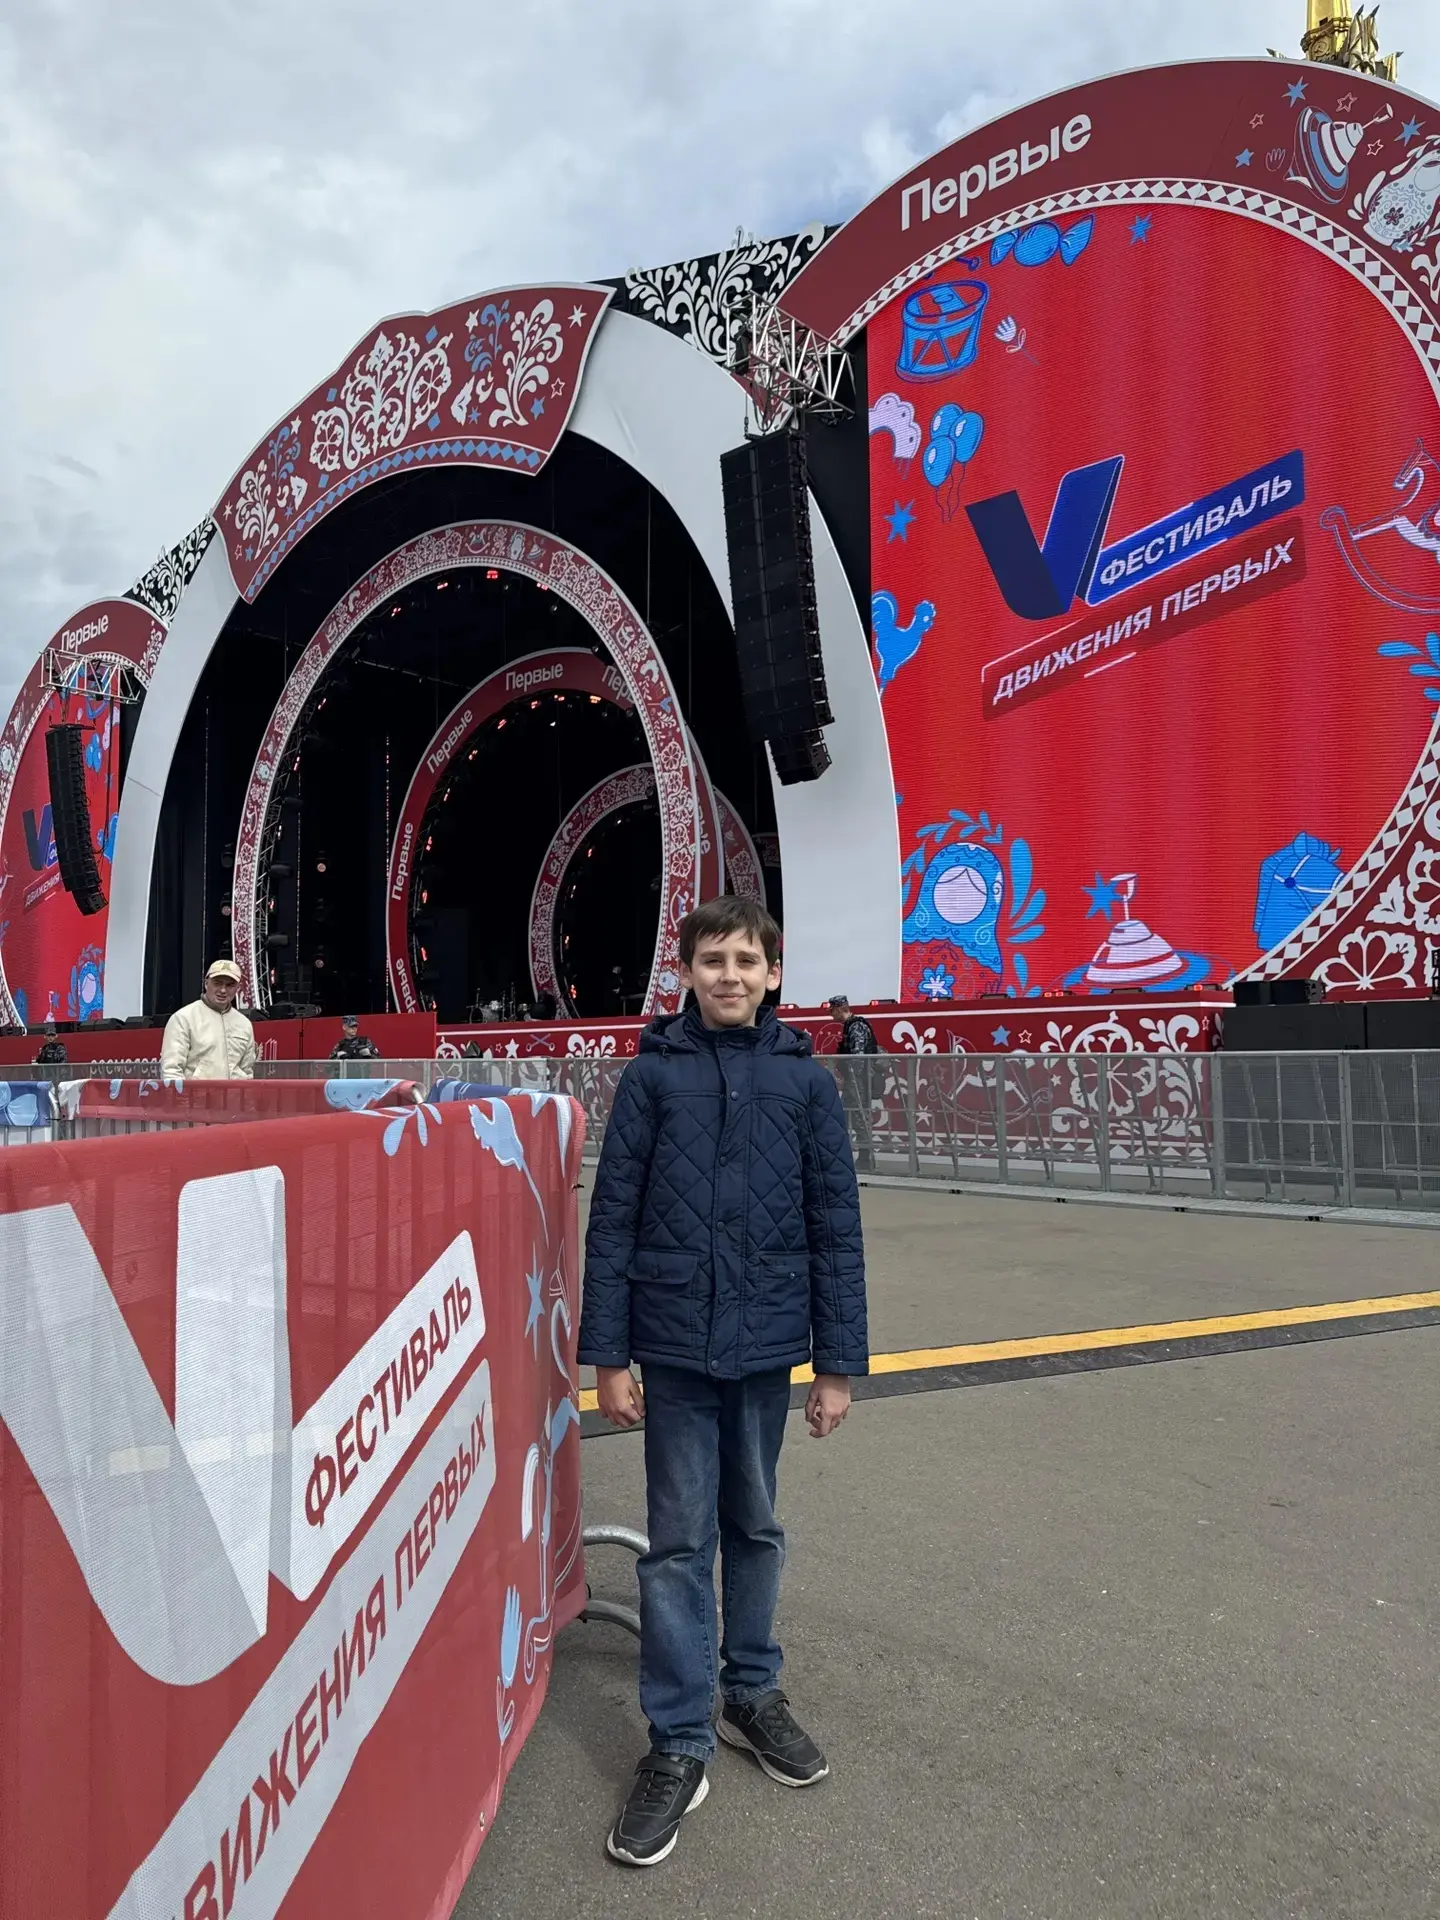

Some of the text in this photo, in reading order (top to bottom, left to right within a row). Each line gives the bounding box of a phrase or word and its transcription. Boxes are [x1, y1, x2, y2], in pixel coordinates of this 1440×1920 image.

[900, 113, 1093, 231] Первые
[1100, 475, 1293, 586] ФЕСТИВАЛЬ
[61, 614, 109, 653] Первые
[505, 662, 564, 691] Первые
[992, 537, 1295, 706] ДВИЖЕНИЯ ПЕРВЫХ
[426, 708, 473, 774] Первые
[391, 822, 413, 900] Первые
[304, 1276, 472, 1528] ФЕСТИВАЛЬ
[172, 1400, 487, 1920] ВИЖЕНИЯ ПЕРВЫХ
